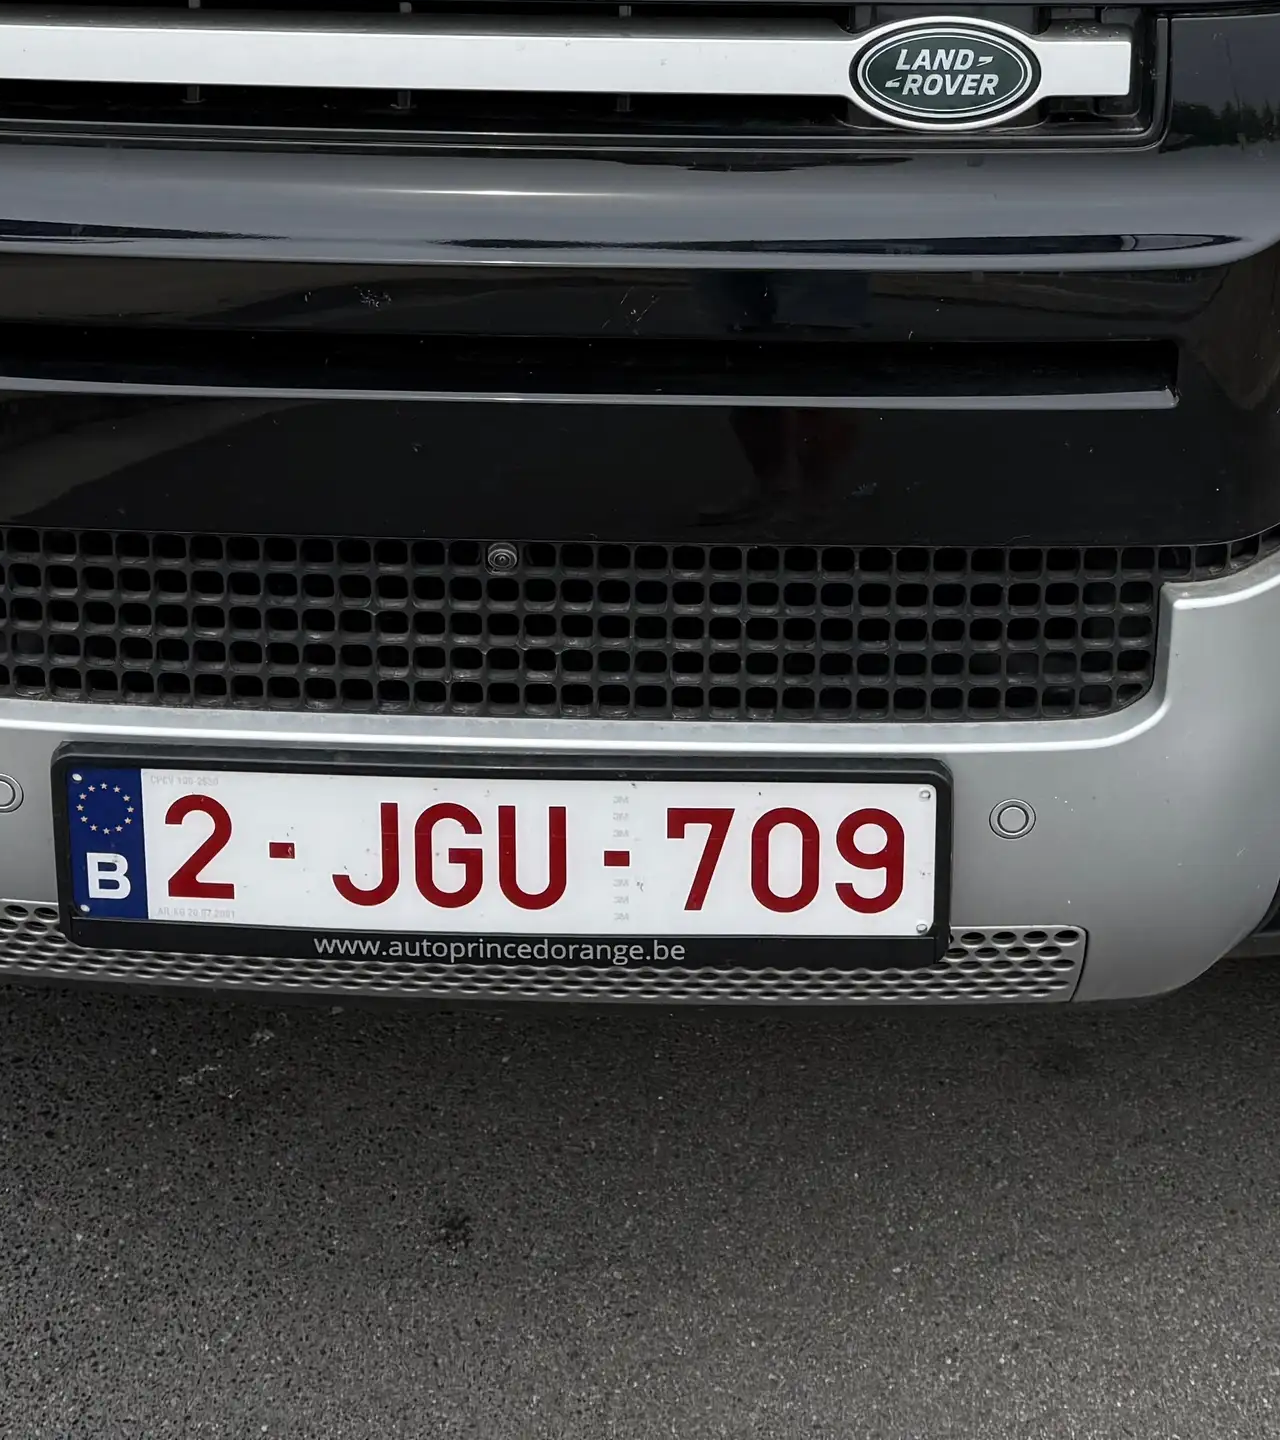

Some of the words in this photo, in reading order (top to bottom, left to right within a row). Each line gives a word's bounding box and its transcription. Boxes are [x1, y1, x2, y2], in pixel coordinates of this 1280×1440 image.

[895, 49, 974, 71] LAND
[901, 74, 999, 95] ROVER
[86, 852, 131, 899] B
[314, 937, 686, 965] www.autoprincedorange.be
